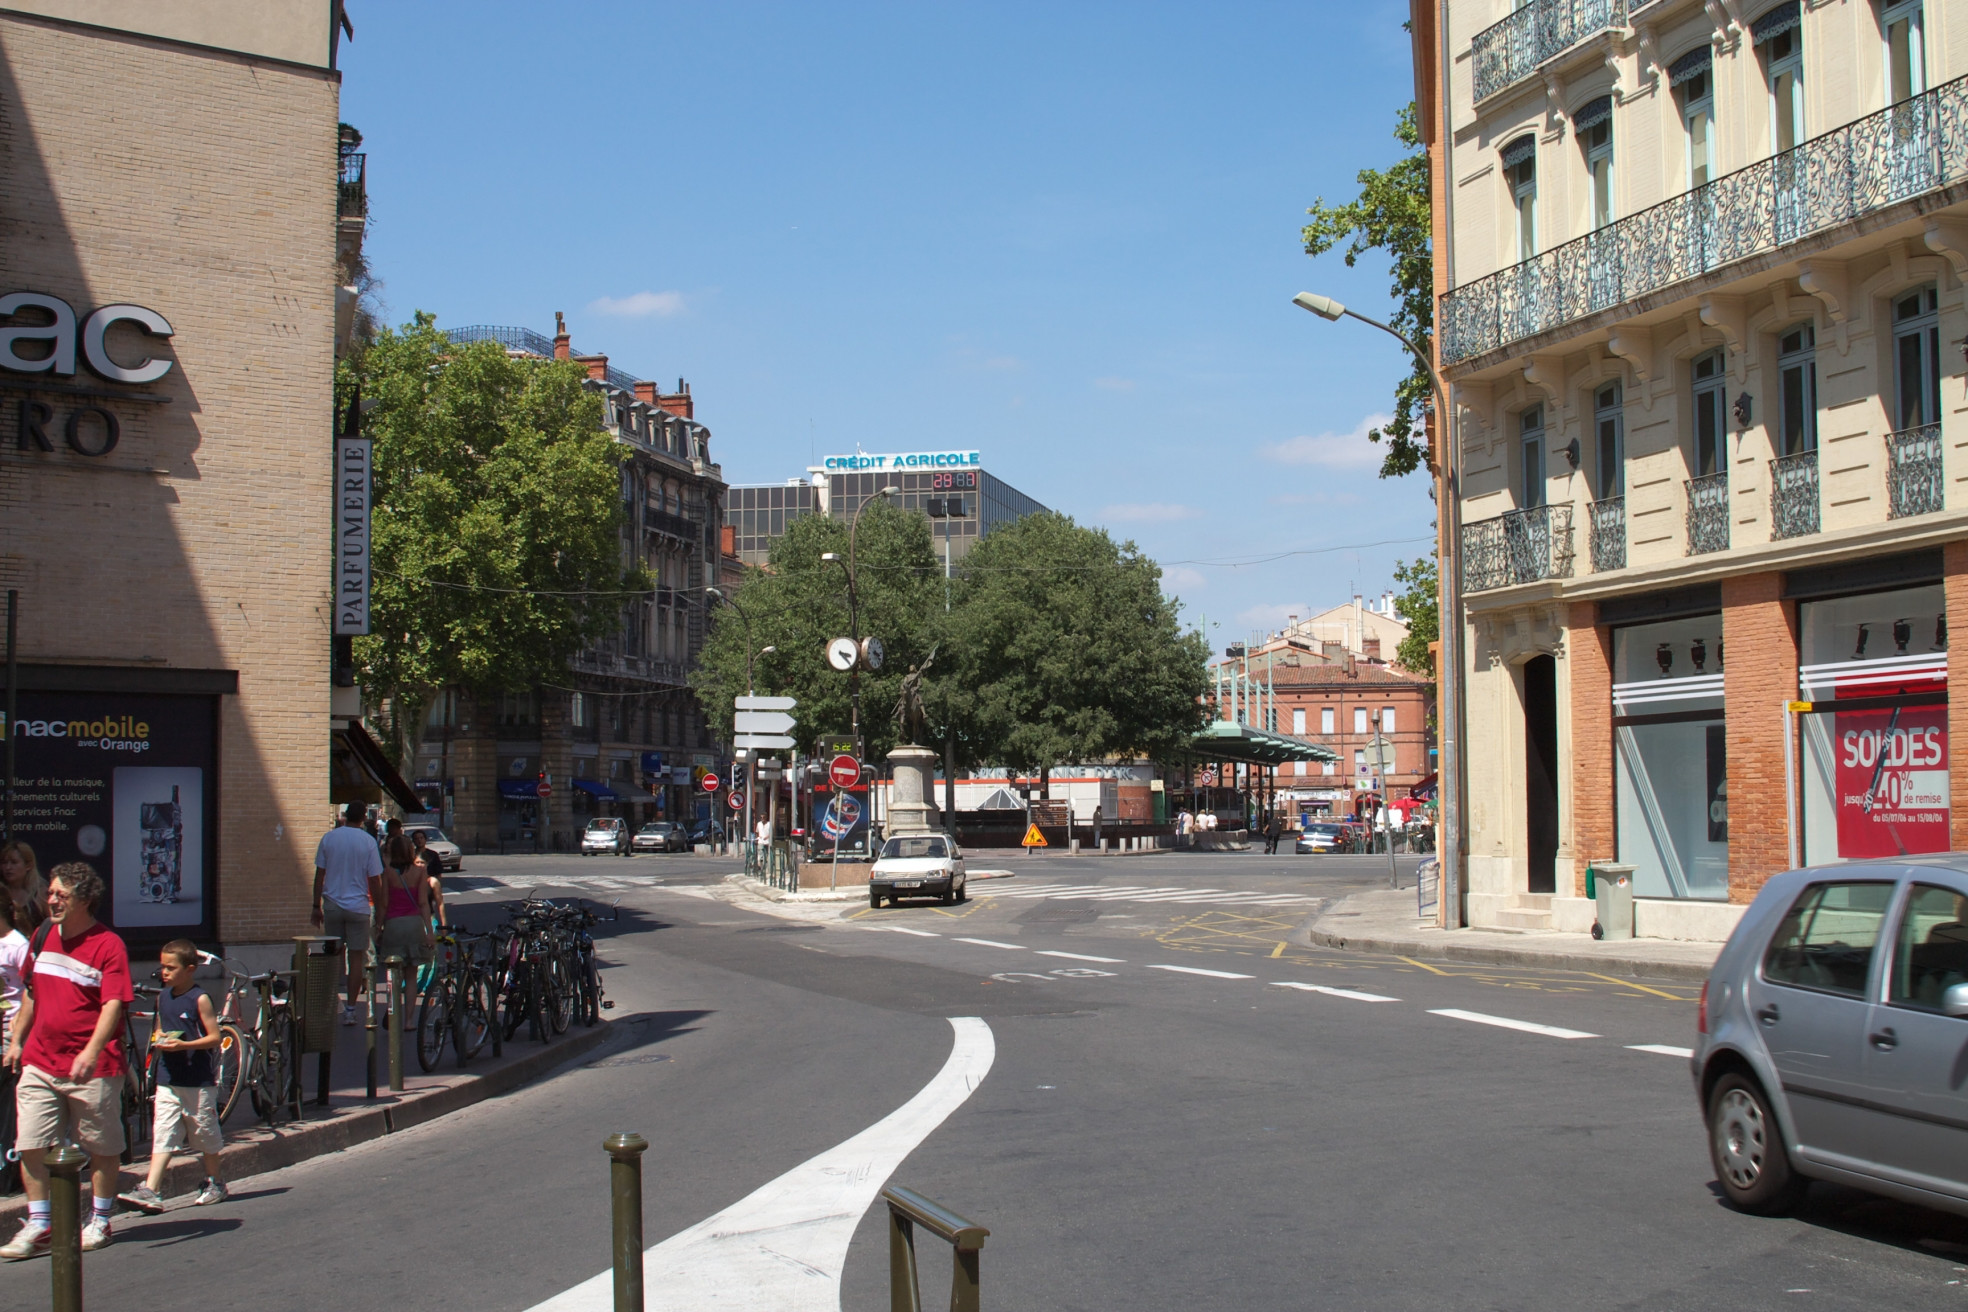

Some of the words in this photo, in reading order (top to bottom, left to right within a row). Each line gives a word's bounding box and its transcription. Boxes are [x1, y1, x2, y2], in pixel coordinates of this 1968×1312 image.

[825, 455, 886, 470] CRÉDIT
[893, 452, 980, 468] AGRICOLE
[342, 447, 364, 627] PARFUMERIE
[0, 711, 150, 739] nacmobile
[100, 737, 150, 753] Orange
[1843, 726, 1942, 768] SOLDES
[1094, 766, 1133, 780] D'ARC
[37, 777, 49, 787] de
[52, 777, 61, 787] la
[64, 778, 105, 789] musique,
[60, 790, 100, 801] culturels
[1904, 793, 1914, 804] de
[1915, 792, 1942, 804] remise
[13, 806, 52, 816] services
[54, 806, 77, 816] Fnac
[1872, 813, 1881, 822] du
[1907, 814, 1916, 822] au
[12, 822, 32, 831] otre
[35, 820, 70, 831] mobile.
